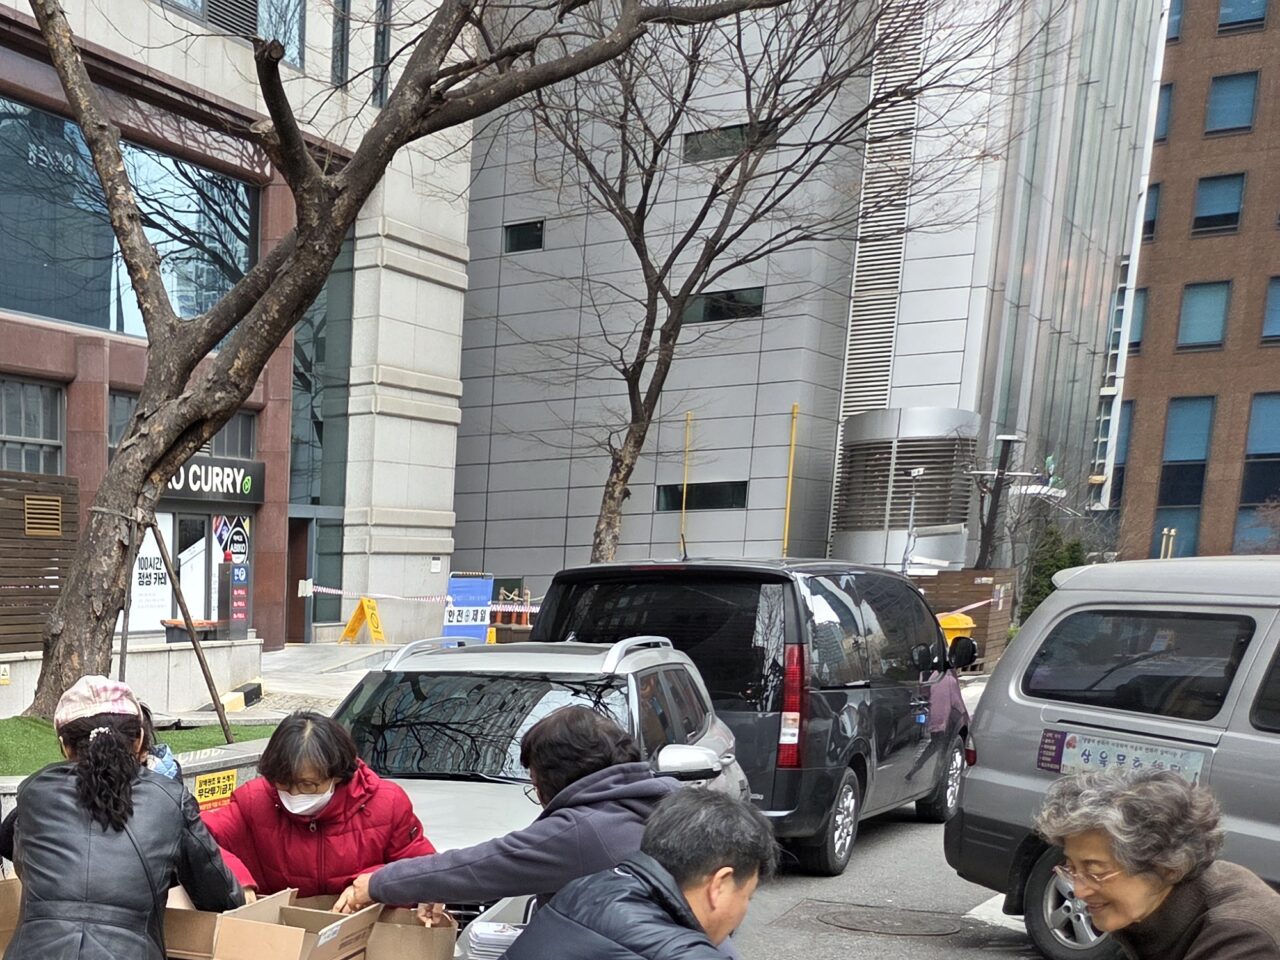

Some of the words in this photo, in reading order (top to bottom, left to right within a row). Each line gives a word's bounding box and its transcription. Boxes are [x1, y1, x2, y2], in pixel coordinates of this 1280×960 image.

[189, 464, 244, 494] CURRY
[138, 556, 162, 571] 100시간
[138, 572, 152, 586] 정성
[153, 572, 167, 586] 카레
[447, 609, 464, 623] 안전
[471, 609, 487, 623] 제일
